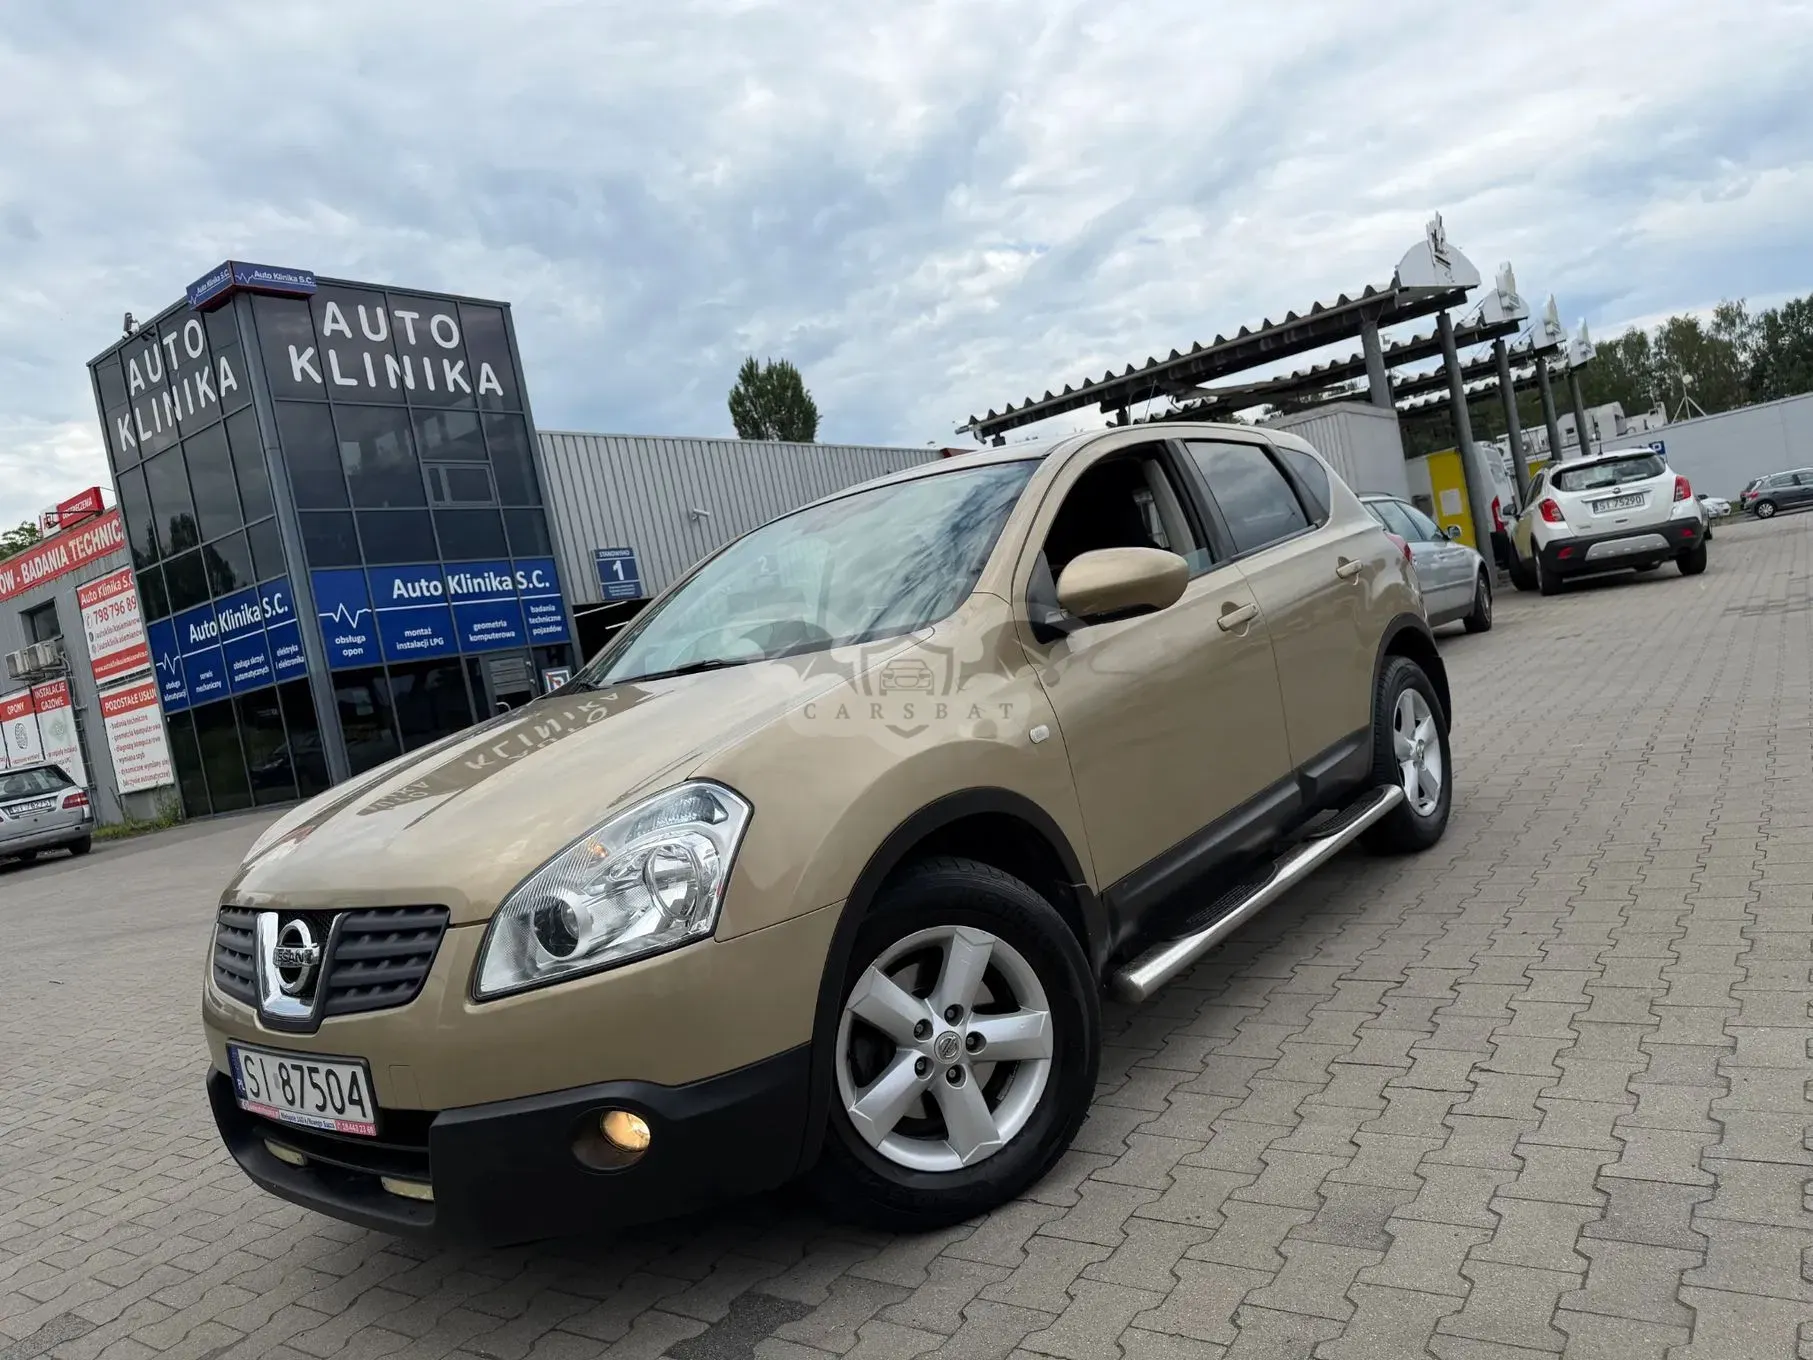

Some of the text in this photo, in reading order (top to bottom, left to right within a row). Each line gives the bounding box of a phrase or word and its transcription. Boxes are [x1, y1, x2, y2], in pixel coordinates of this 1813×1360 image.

[254, 270, 272, 279] Auto
[273, 272, 298, 283] Klinika
[323, 301, 460, 349] AUTO
[128, 319, 204, 396] AUTO
[288, 344, 503, 396] KLINIKA
[117, 356, 238, 452] KLINIKA
[21, 545, 70, 584] BADANIA
[613, 560, 625, 580] 1
[392, 569, 550, 599] Auto Klinika S.C.
[81, 590, 98, 606] Auto
[98, 580, 122, 599] Klinika
[93, 607, 110, 625] 798
[109, 600, 126, 619] 796
[530, 604, 556, 613] badania
[189, 592, 289, 644] Auto Klinika S.C.
[529, 615, 561, 624] techniczne
[404, 627, 432, 637] montaż
[473, 620, 507, 632] geometria
[532, 625, 562, 636] pojazdów
[335, 634, 366, 645] obsługa
[468, 630, 516, 642] komputerowa
[276, 644, 299, 657] elektryka
[396, 637, 444, 651] instalacji LPG
[342, 647, 364, 657] opon
[279, 655, 305, 670] elektronika
[34, 682, 66, 700] INSTALACJE
[7, 702, 25, 715] OPONY
[40, 697, 64, 711] GAZOWE
[244, 1055, 367, 1118] SI 87504
